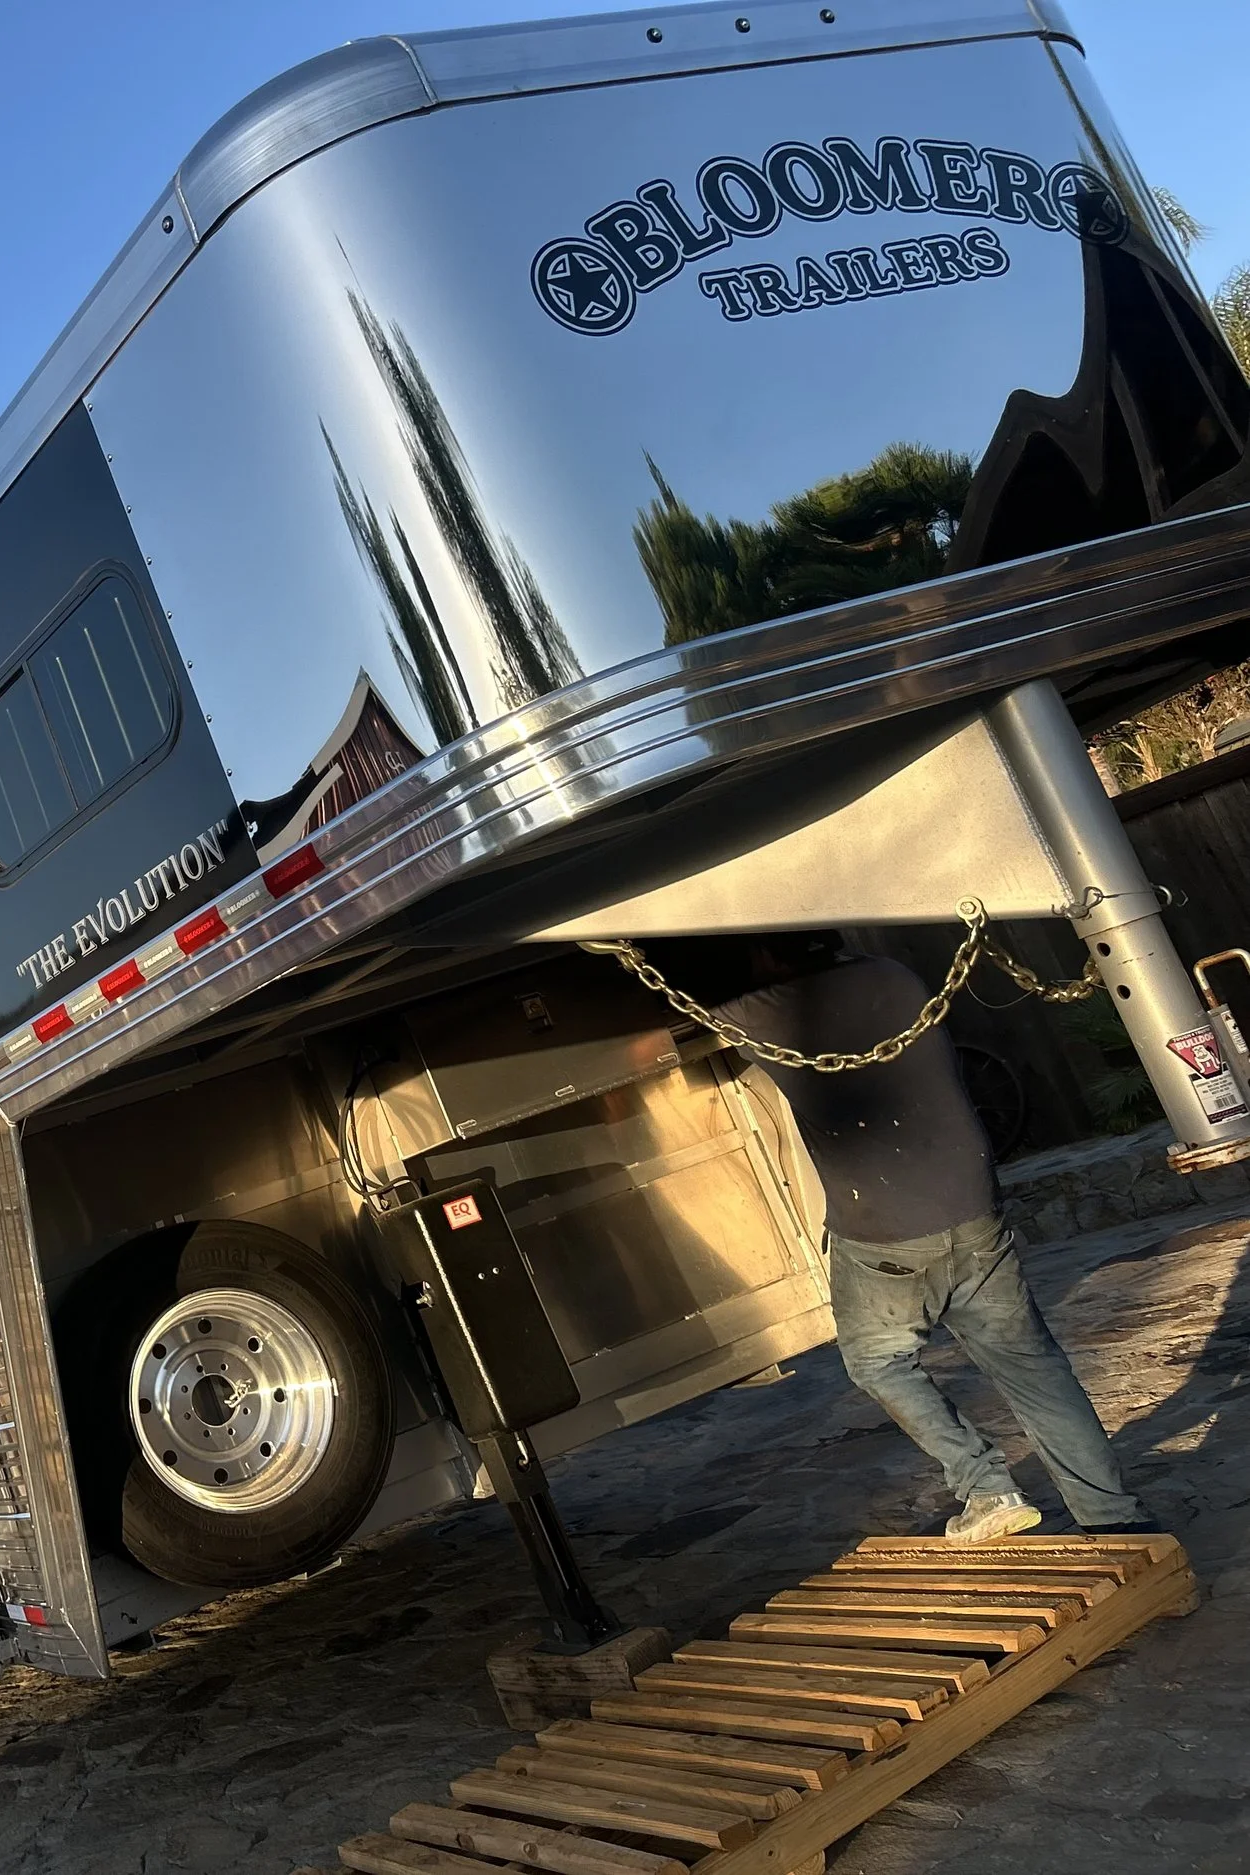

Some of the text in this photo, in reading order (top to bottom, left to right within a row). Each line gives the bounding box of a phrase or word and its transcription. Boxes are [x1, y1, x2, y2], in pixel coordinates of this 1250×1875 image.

[586, 136, 1063, 293] BLOOMER
[698, 227, 1010, 322] TRAILERS
[1174, 1032, 1215, 1051] BULLDOG
[451, 1202, 471, 1217] EQ
